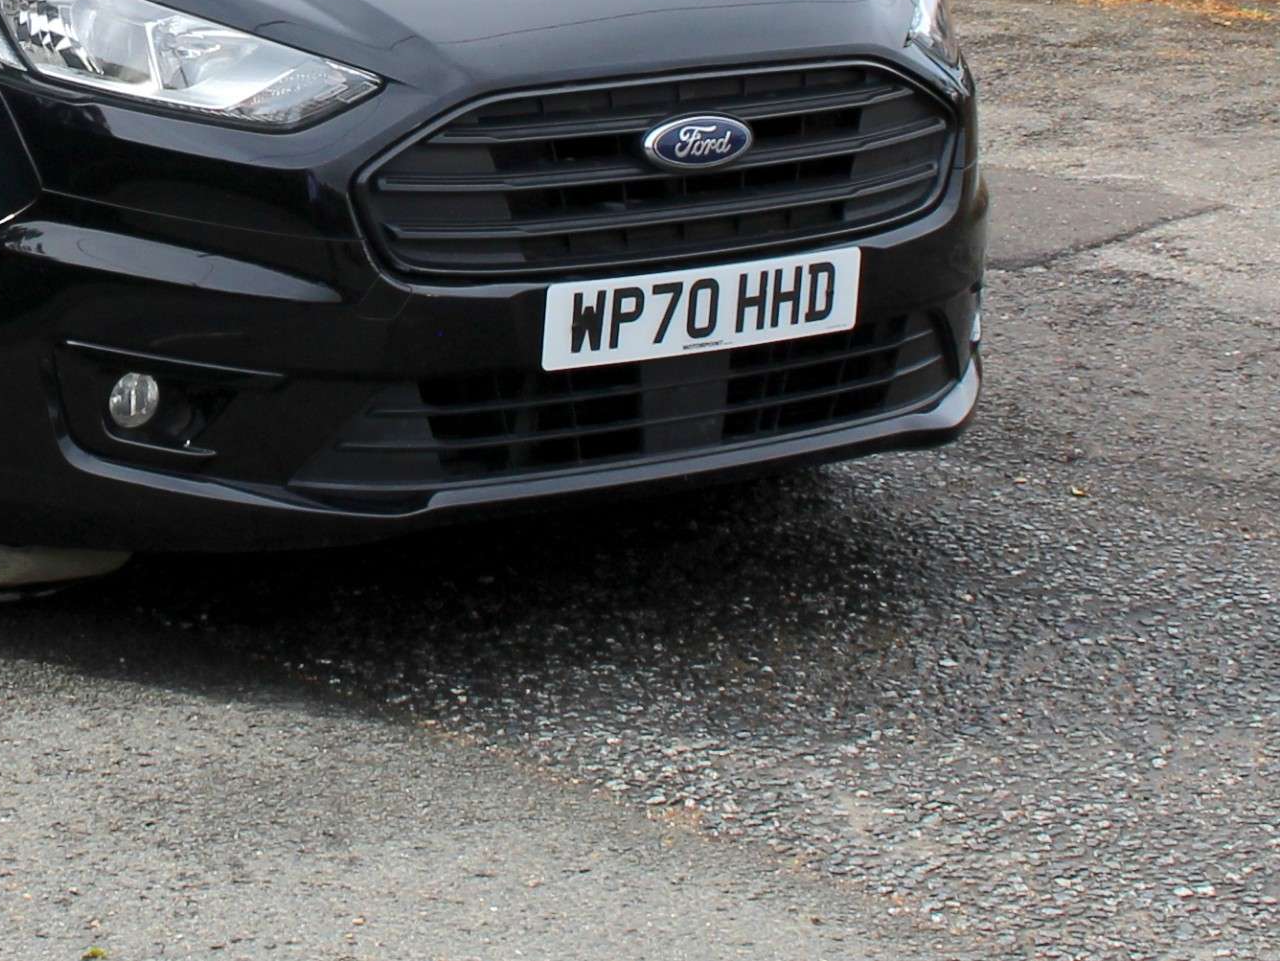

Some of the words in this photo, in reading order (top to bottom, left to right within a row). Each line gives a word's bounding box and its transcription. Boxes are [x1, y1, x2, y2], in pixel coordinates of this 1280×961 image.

[675, 125, 732, 158] Ford
[571, 277, 719, 354] WP70
[735, 262, 836, 333] HHD
